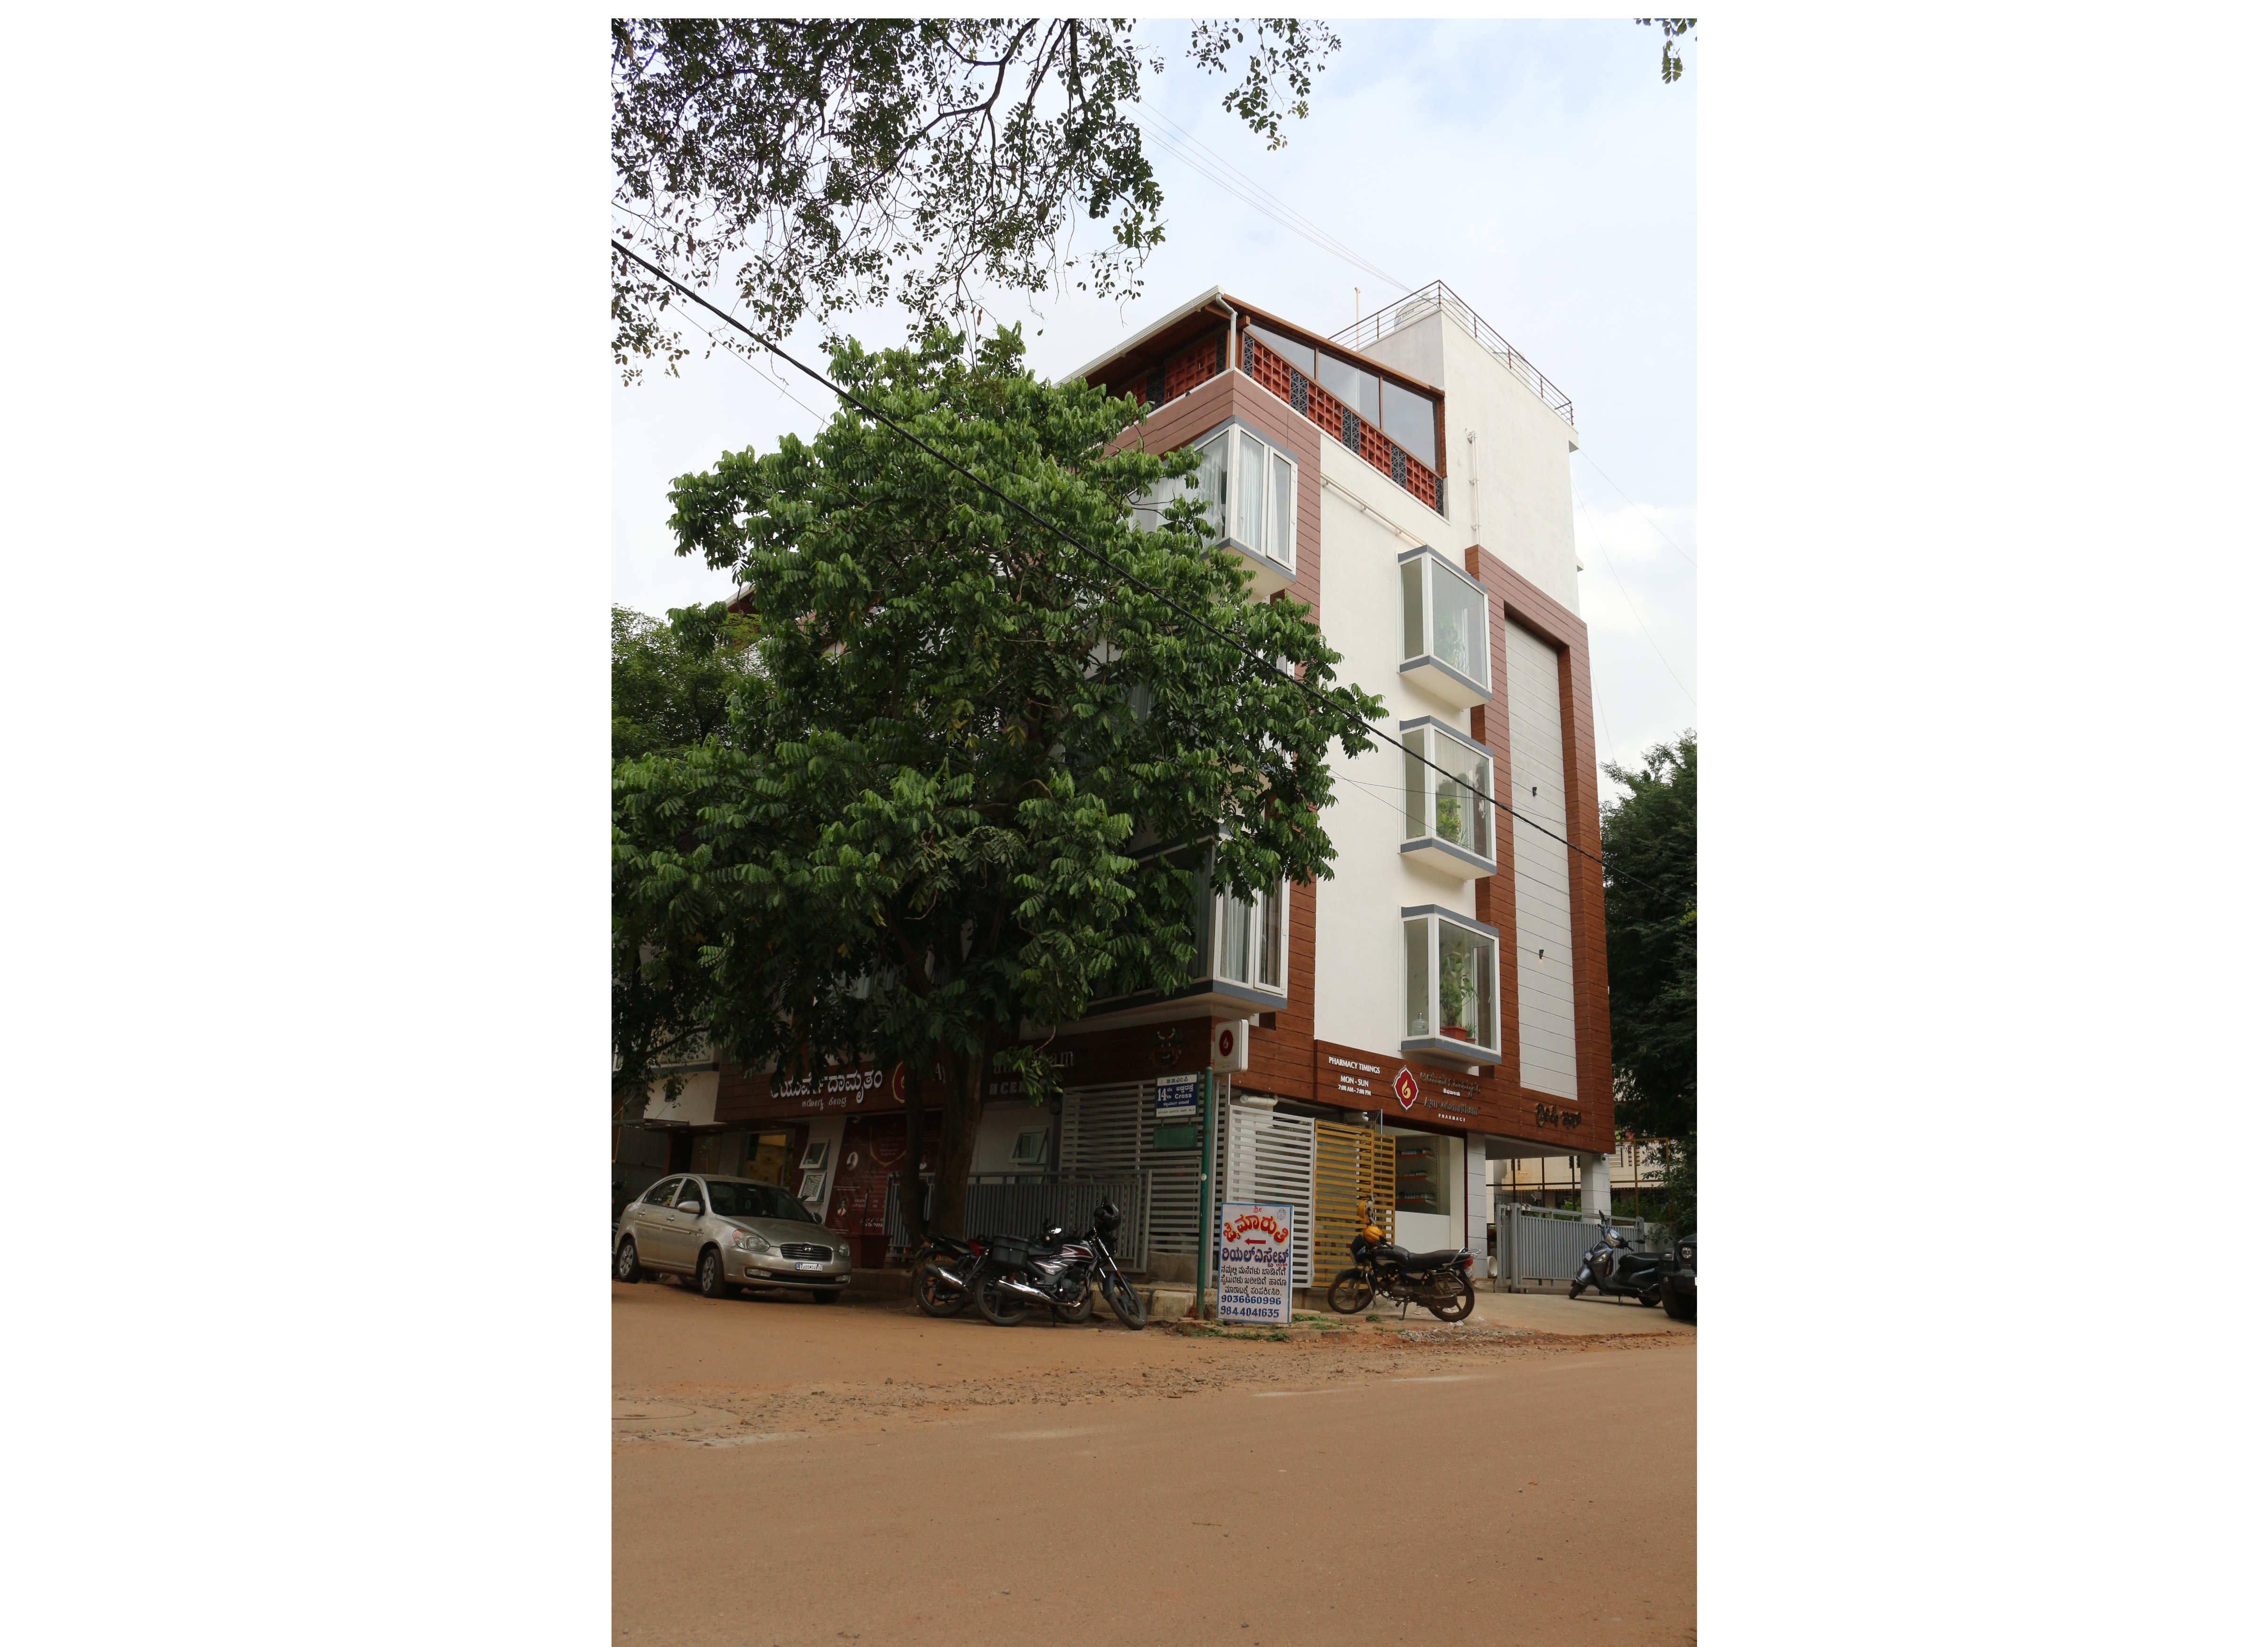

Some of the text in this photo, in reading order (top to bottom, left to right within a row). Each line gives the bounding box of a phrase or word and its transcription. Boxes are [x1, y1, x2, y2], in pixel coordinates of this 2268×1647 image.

[1329, 1057, 1380, 1074] PHARMACY TIMINGS
[1340, 1075, 1354, 1084] MON
[1358, 1079, 1369, 1087] SUN
[802, 1097, 847, 1110] ಆರೋಗ್ಯ ಕೇಂದ್ರ
[1438, 1114, 1466, 1122] PHARMACY
[1221, 1265, 1286, 1276] ನಮ್ಮಲ್ಲಿ ಮನೆಗಳು ಬಾಡಿಗೆಗೆ
[1244, 1277, 1266, 1285] ಖರೀದಿಗೆ
[1269, 1278, 1287, 1286] ಹಾಗೂ
[1221, 1295, 1281, 1305] 9036660996
[1220, 1305, 1280, 1318] 9844041635
